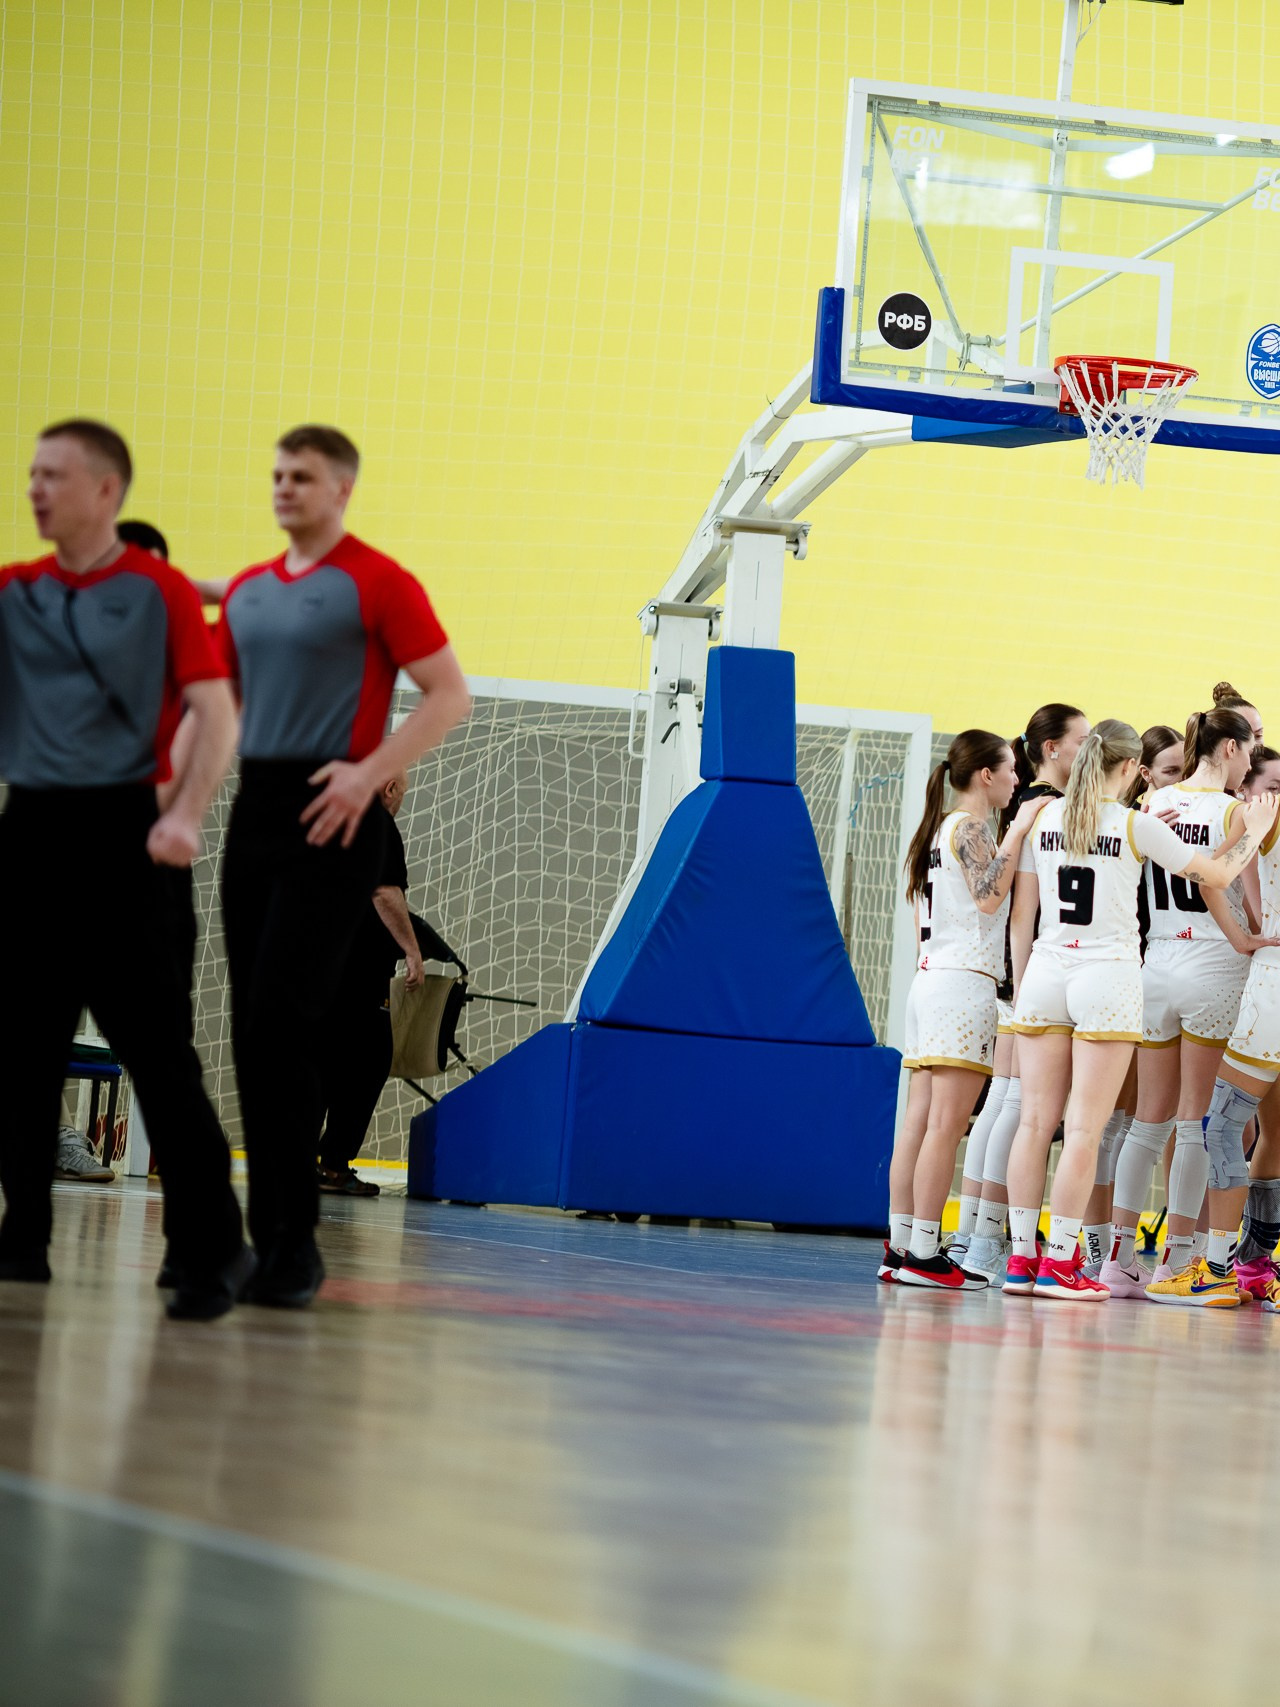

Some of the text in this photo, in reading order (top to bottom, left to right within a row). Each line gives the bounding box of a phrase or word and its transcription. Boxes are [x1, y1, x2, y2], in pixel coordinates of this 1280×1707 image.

[892, 125, 945, 149] FON
[884, 311, 926, 332] РФБ
[1058, 865, 1095, 926] 9
